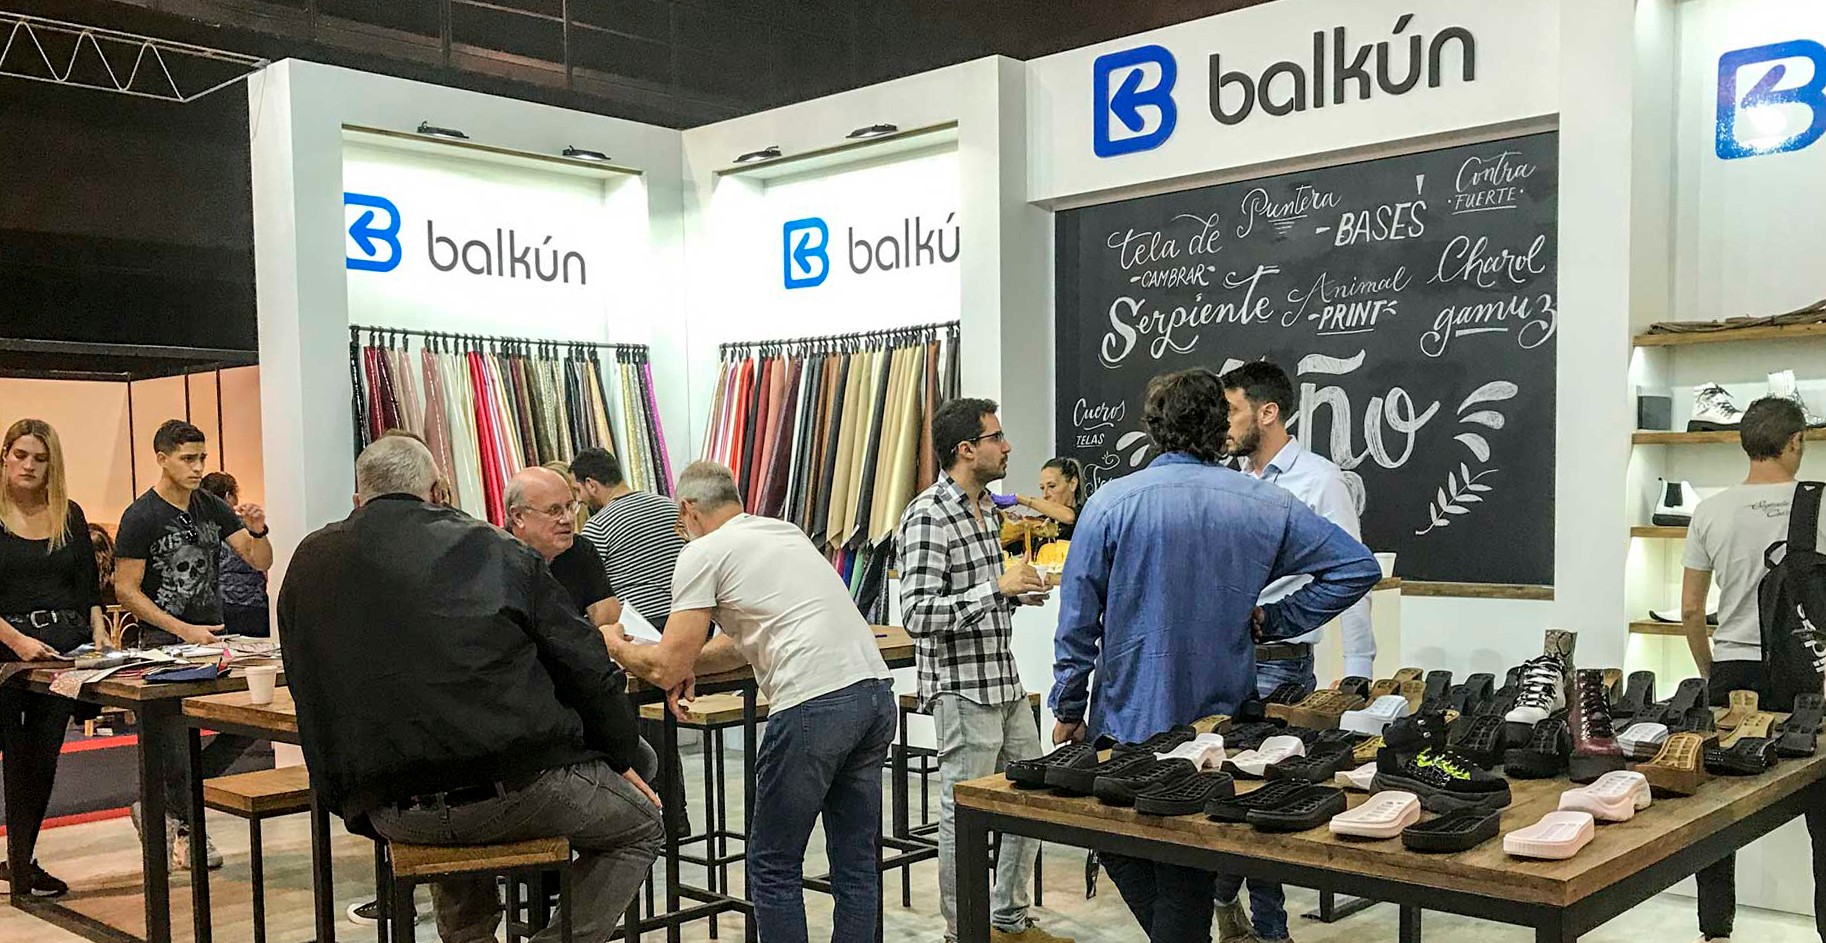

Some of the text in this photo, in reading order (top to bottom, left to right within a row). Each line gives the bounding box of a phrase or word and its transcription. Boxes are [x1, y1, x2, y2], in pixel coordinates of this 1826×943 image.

[1208, 13, 1476, 126] balkún
[1455, 150, 1537, 193] Contra
[1236, 184, 1343, 240] Puntera
[1333, 199, 1428, 247] BASES
[1454, 186, 1518, 210] FUERTE
[426, 219, 587, 286] balkún
[1107, 212, 1223, 270] tela de
[1426, 234, 1546, 288] Charol
[1140, 263, 1210, 289] CAMBRAR
[1281, 265, 1413, 327] Animal
[1099, 264, 1282, 364] Serpiente
[1317, 300, 1388, 330] PRINT
[1073, 397, 1126, 427] Cueros
[1075, 432, 1106, 447] TELAS
